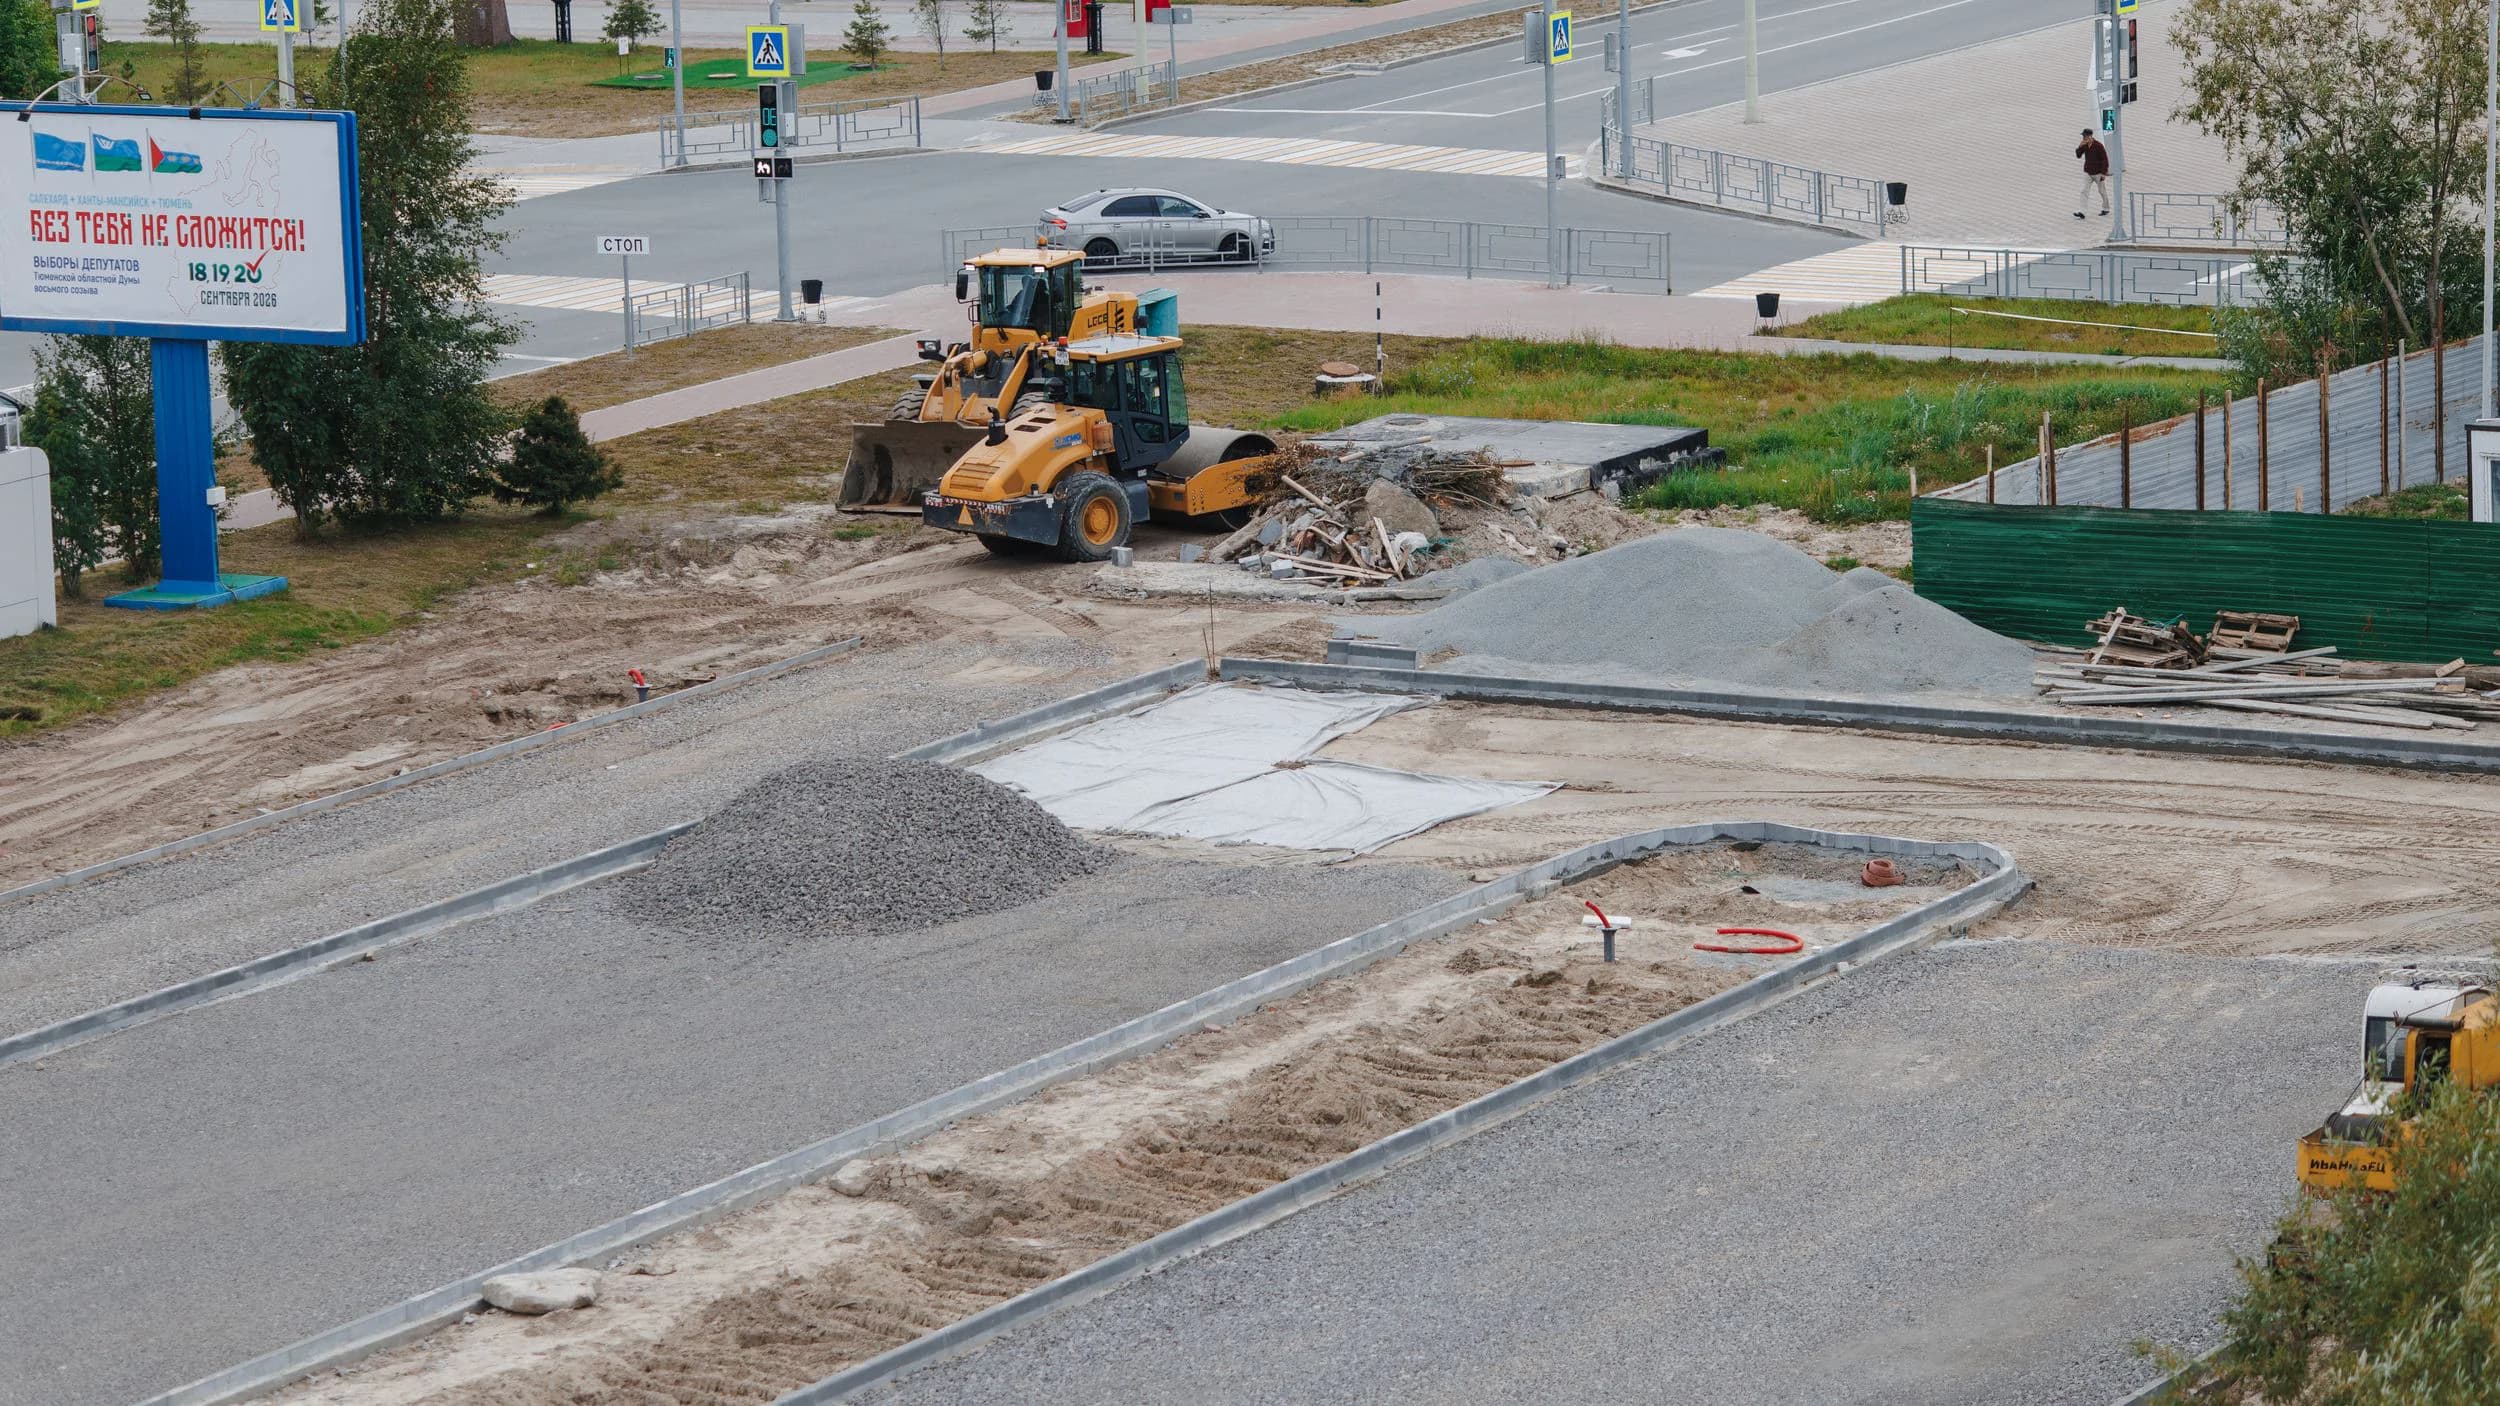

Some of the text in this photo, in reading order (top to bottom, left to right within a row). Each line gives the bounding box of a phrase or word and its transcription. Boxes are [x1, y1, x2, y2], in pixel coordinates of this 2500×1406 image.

[29, 192, 69, 206] САЛЕХАРД
[77, 194, 149, 208] ХАНТЫ-МАНСИЙСК
[159, 198, 193, 209] ТЮМЕНЬ
[30, 209, 305, 252] БЕЗ ТЕБЯ НЕ СЛОЖИТСЯ!
[603, 238, 643, 252] СТОП
[33, 255, 140, 272] ВЫБОРЫ ДЕПУТАТОВ
[34, 271, 140, 287] Тюменской областной Думы
[233, 263, 262, 284] 20
[34, 285, 98, 295] восьмого созыва
[200, 290, 277, 308] СЕНТЯБРЯ 2026
[2310, 1159, 2386, 1173] ИВАНВЕЦ
